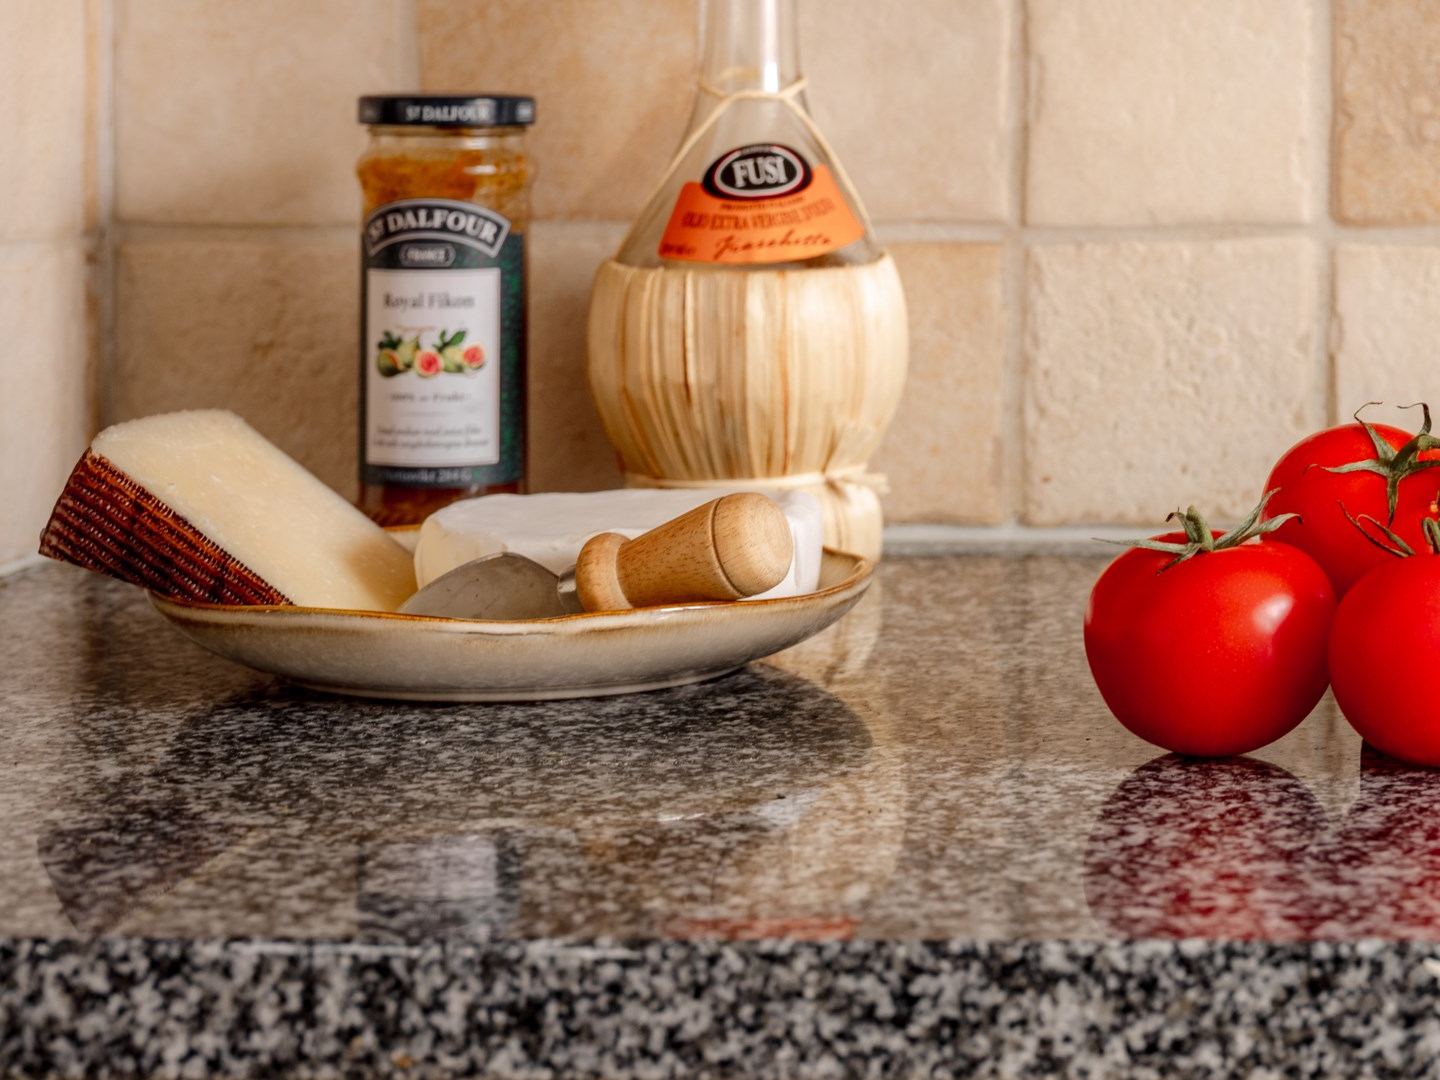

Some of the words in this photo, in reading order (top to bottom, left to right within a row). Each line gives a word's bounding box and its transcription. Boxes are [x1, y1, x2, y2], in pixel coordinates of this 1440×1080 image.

[422, 104, 490, 121] DALFOUR
[732, 155, 787, 188] FUSI
[387, 208, 498, 244] DALFOUR
[383, 292, 424, 313] Royal
[428, 292, 476, 309] Fikon
